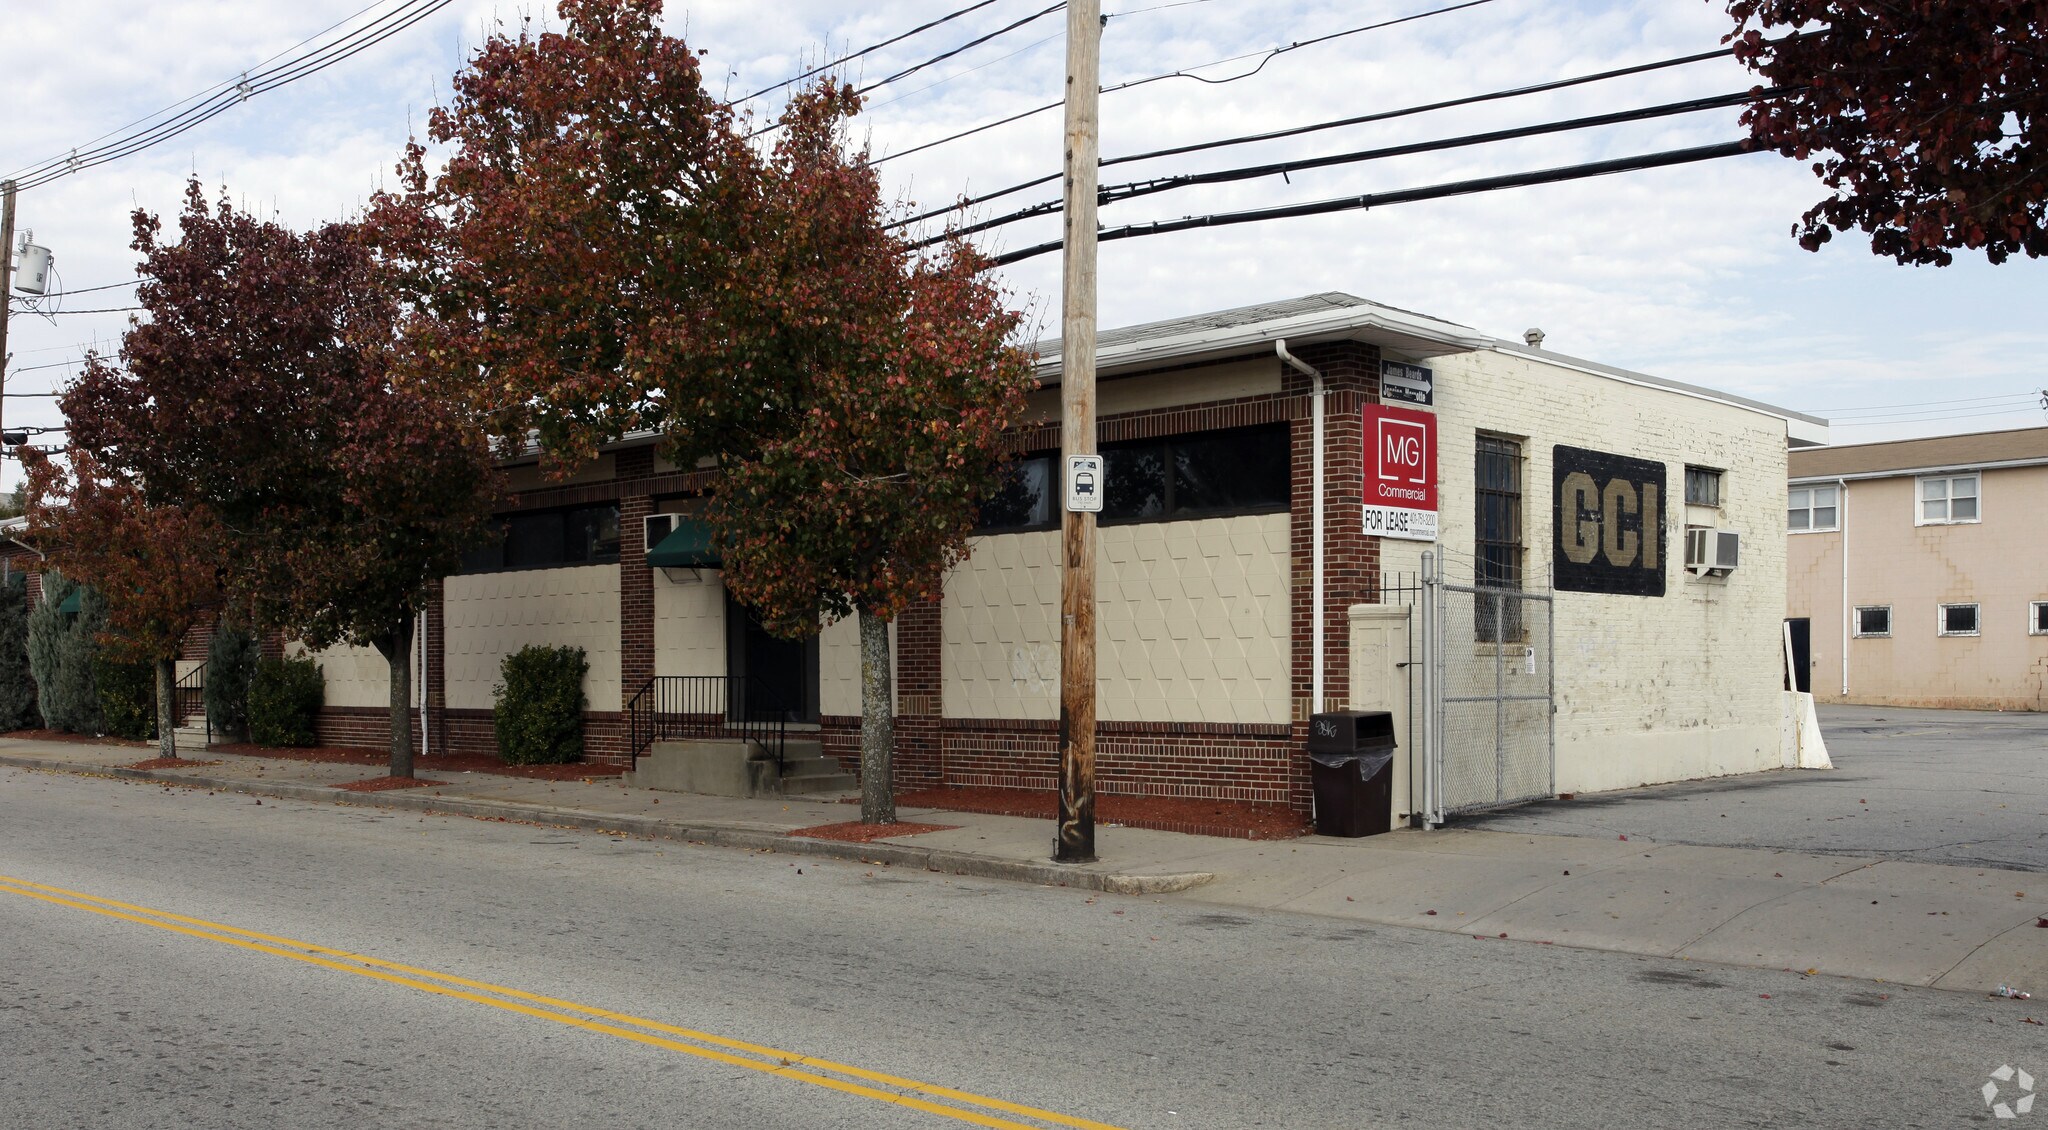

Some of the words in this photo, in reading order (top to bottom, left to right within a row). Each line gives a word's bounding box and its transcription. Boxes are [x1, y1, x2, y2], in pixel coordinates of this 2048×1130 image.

[1386, 363, 1403, 377] James
[1387, 434, 1419, 467] MG
[1378, 483, 1426, 501] Commercial
[1365, 509, 1383, 530] FOR
[1386, 511, 1408, 531] LEASE
[1561, 471, 1658, 569] GCI
